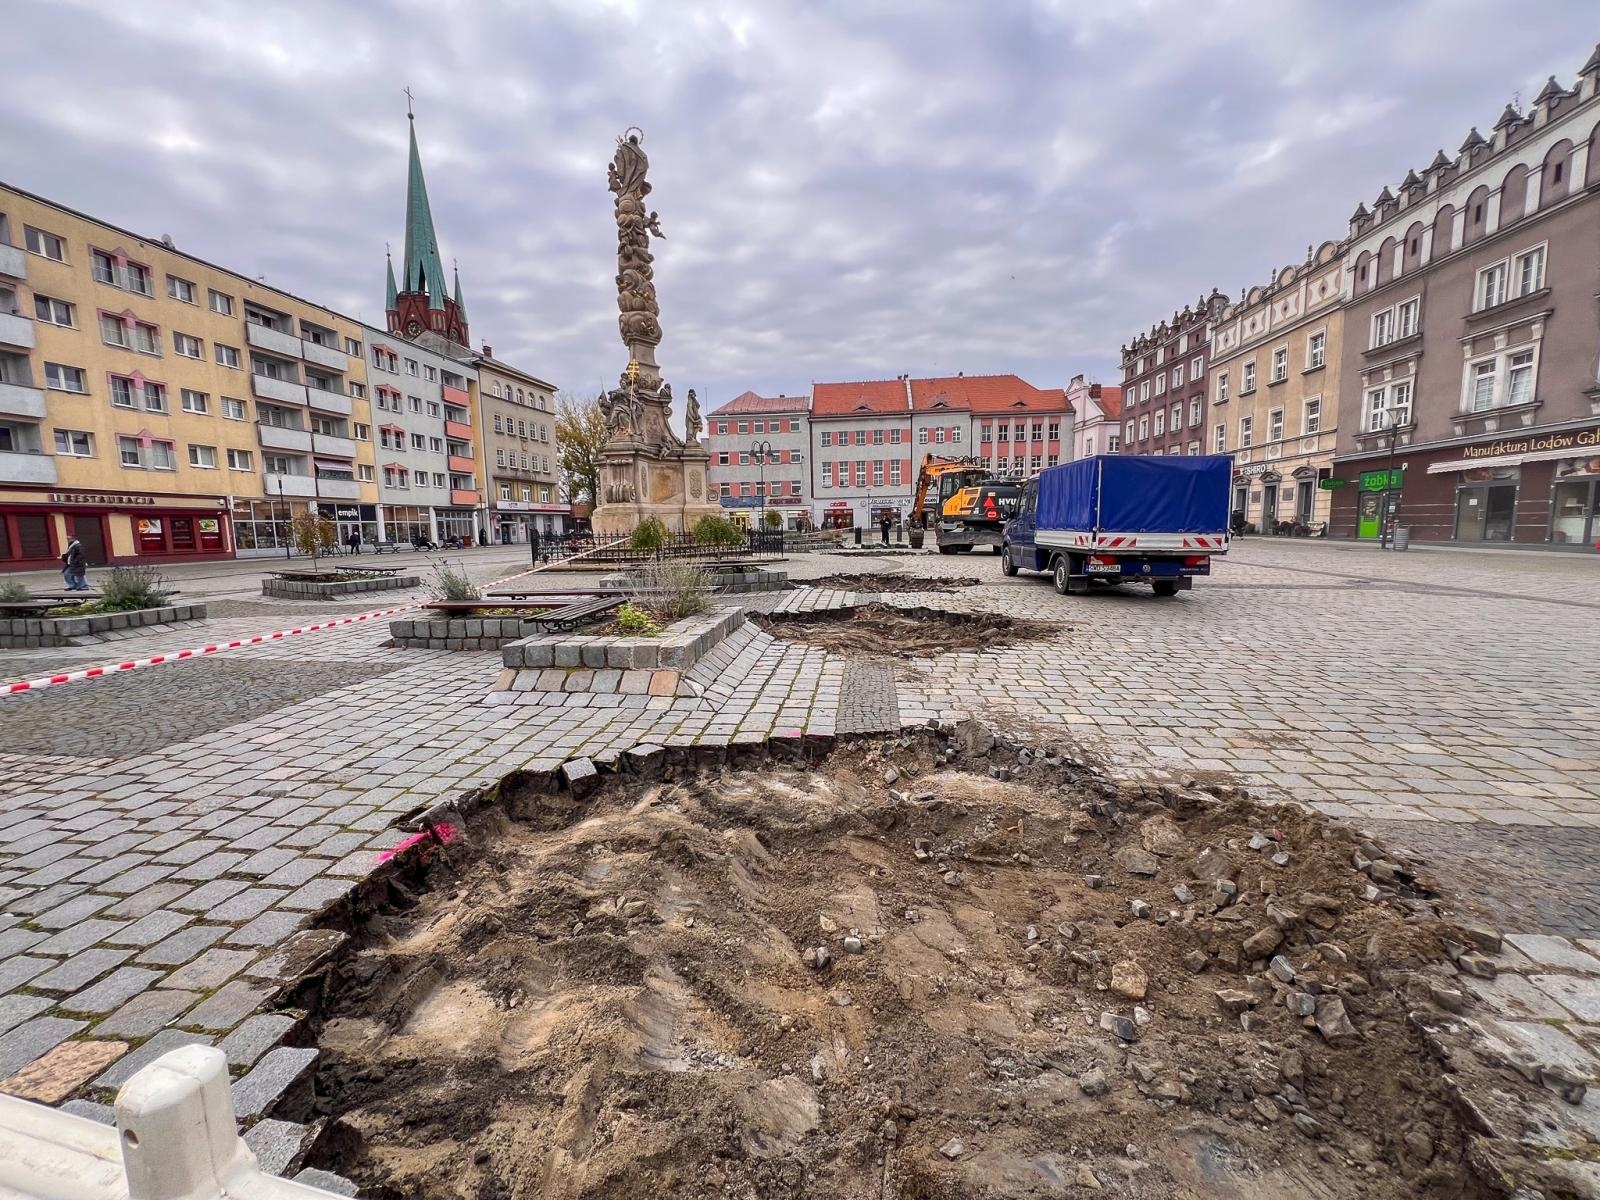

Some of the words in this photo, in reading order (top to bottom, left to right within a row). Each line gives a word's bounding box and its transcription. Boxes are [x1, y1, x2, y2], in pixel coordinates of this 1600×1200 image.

[1464, 442, 1527, 457] Manufaktura
[1531, 435, 1573, 450] Lodów
[65, 494, 155, 505] RESTAURACJA
[338, 508, 358, 518] empik
